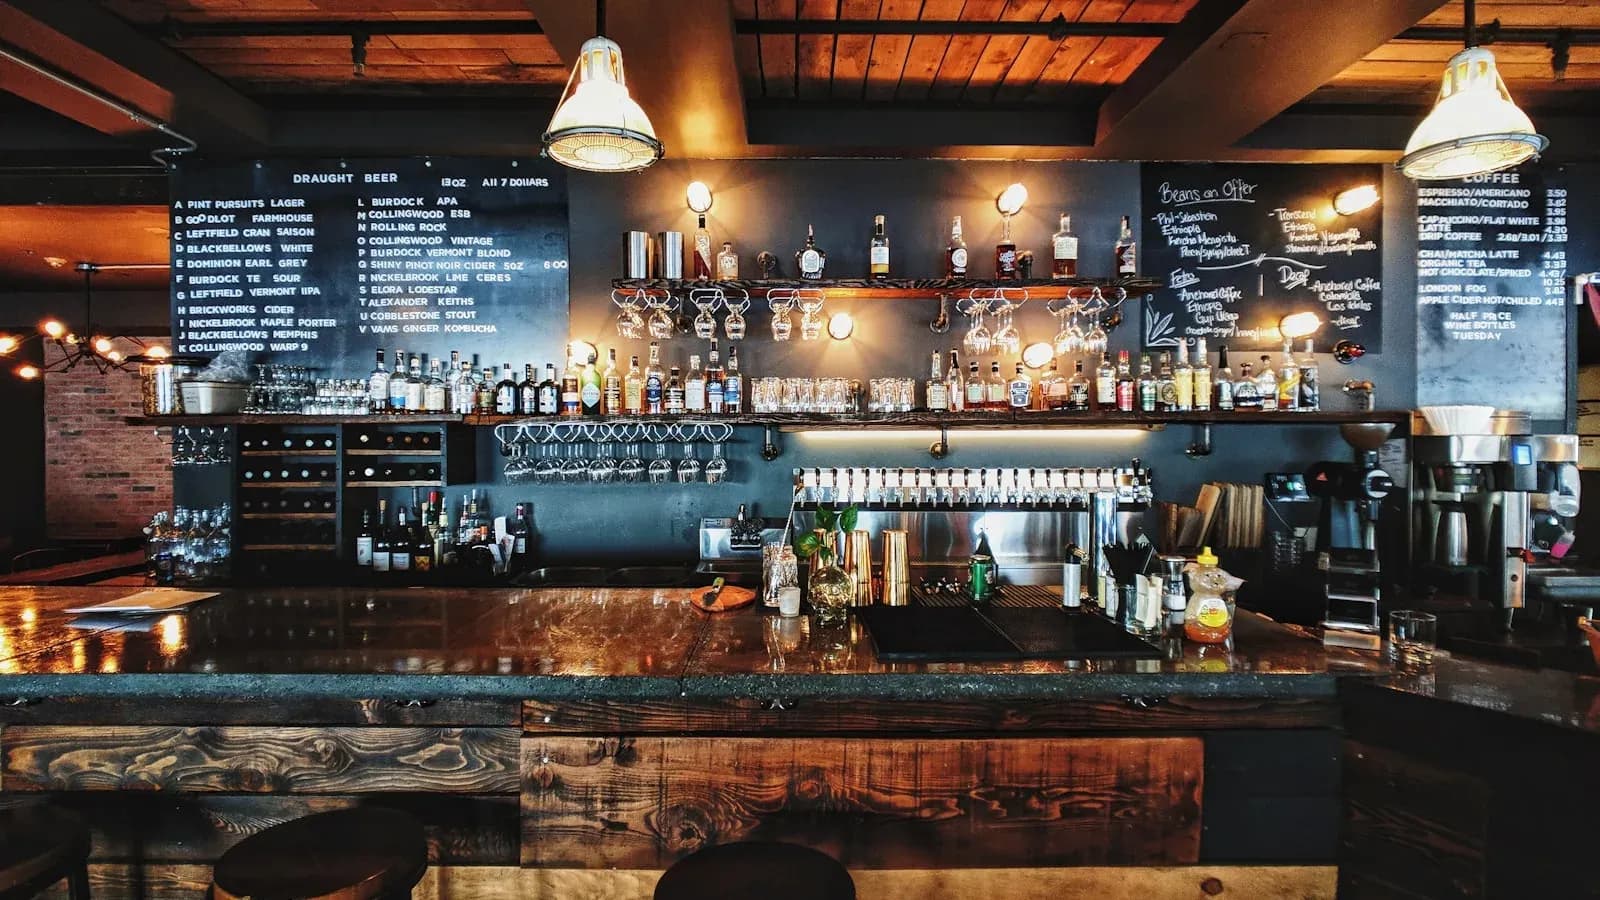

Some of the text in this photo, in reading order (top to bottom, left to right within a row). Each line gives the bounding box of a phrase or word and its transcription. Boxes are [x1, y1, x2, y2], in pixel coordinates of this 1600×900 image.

[293, 174, 398, 183] DRAUGHT BEER
[501, 179, 507, 187] 7
[1463, 174, 1519, 183] COFFEE
[1159, 182, 1200, 203] Beans
[1223, 178, 1258, 200] Offer
[1418, 189, 1530, 197] ESPRESSO/AMERICANO
[215, 200, 264, 208] PURSUITS
[372, 198, 424, 206] BURDOCK
[437, 197, 458, 205] APA
[1418, 198, 1528, 208] MACCHIATO/CORTADO
[175, 216, 182, 224] B
[252, 214, 312, 222] FARMHOUSE
[357, 210, 470, 220] M COLLINGWOOD ESB
[1418, 216, 1506, 224] CAPPUCCINO/FLAT
[358, 223, 447, 232] N ROLLING ROCK
[1418, 224, 1451, 232] LATTE
[175, 228, 314, 240] C LEFTFIELD CRAN SAISON
[357, 237, 493, 245] O COLLINGWOOD VINTAGE
[187, 245, 272, 253] BLACKBELLOWS
[281, 244, 312, 252] WHITE
[359, 249, 365, 257] P
[371, 249, 421, 257] BURDOCK
[427, 249, 473, 257] VERMONT
[1418, 250, 1487, 258] CHAI/MATCHA
[187, 260, 241, 268] DOMINION
[245, 259, 272, 267] EARL
[370, 261, 400, 269] SHINY
[437, 262, 460, 270] NOIR
[464, 262, 495, 270] CIDER
[1278, 265, 1310, 286] Decaf
[1418, 269, 1439, 277] HOT
[1441, 269, 1531, 277] CHOCOLATE/SPIKED
[189, 275, 239, 284] BURDOCK
[371, 274, 438, 282] NICKELBROOK
[191, 289, 243, 298] LEFTFIELD
[249, 288, 296, 296] VERMONT
[359, 286, 458, 294] S ELORA LODESTAR
[360, 298, 367, 306] T
[368, 298, 428, 307] ALEXANDER
[1418, 296, 1450, 304] APPLE
[1452, 296, 1482, 304] CIDER
[190, 306, 256, 314] BRICKWORKS
[1327, 302, 1345, 311] Los
[360, 311, 476, 320] U COBBLESTONE STOUT
[1483, 312, 1511, 320] PRICE
[189, 319, 255, 328] NICKELBROOK
[1474, 321, 1516, 329] BOTTLES
[371, 325, 398, 333] VAMS
[403, 325, 439, 333] GINGER
[444, 324, 496, 333] KOMBUCHA
[188, 331, 268, 339] BLACKBELLOWS
[1453, 332, 1501, 340] TUESDAY
[189, 344, 264, 352] COLLINGWOOD
